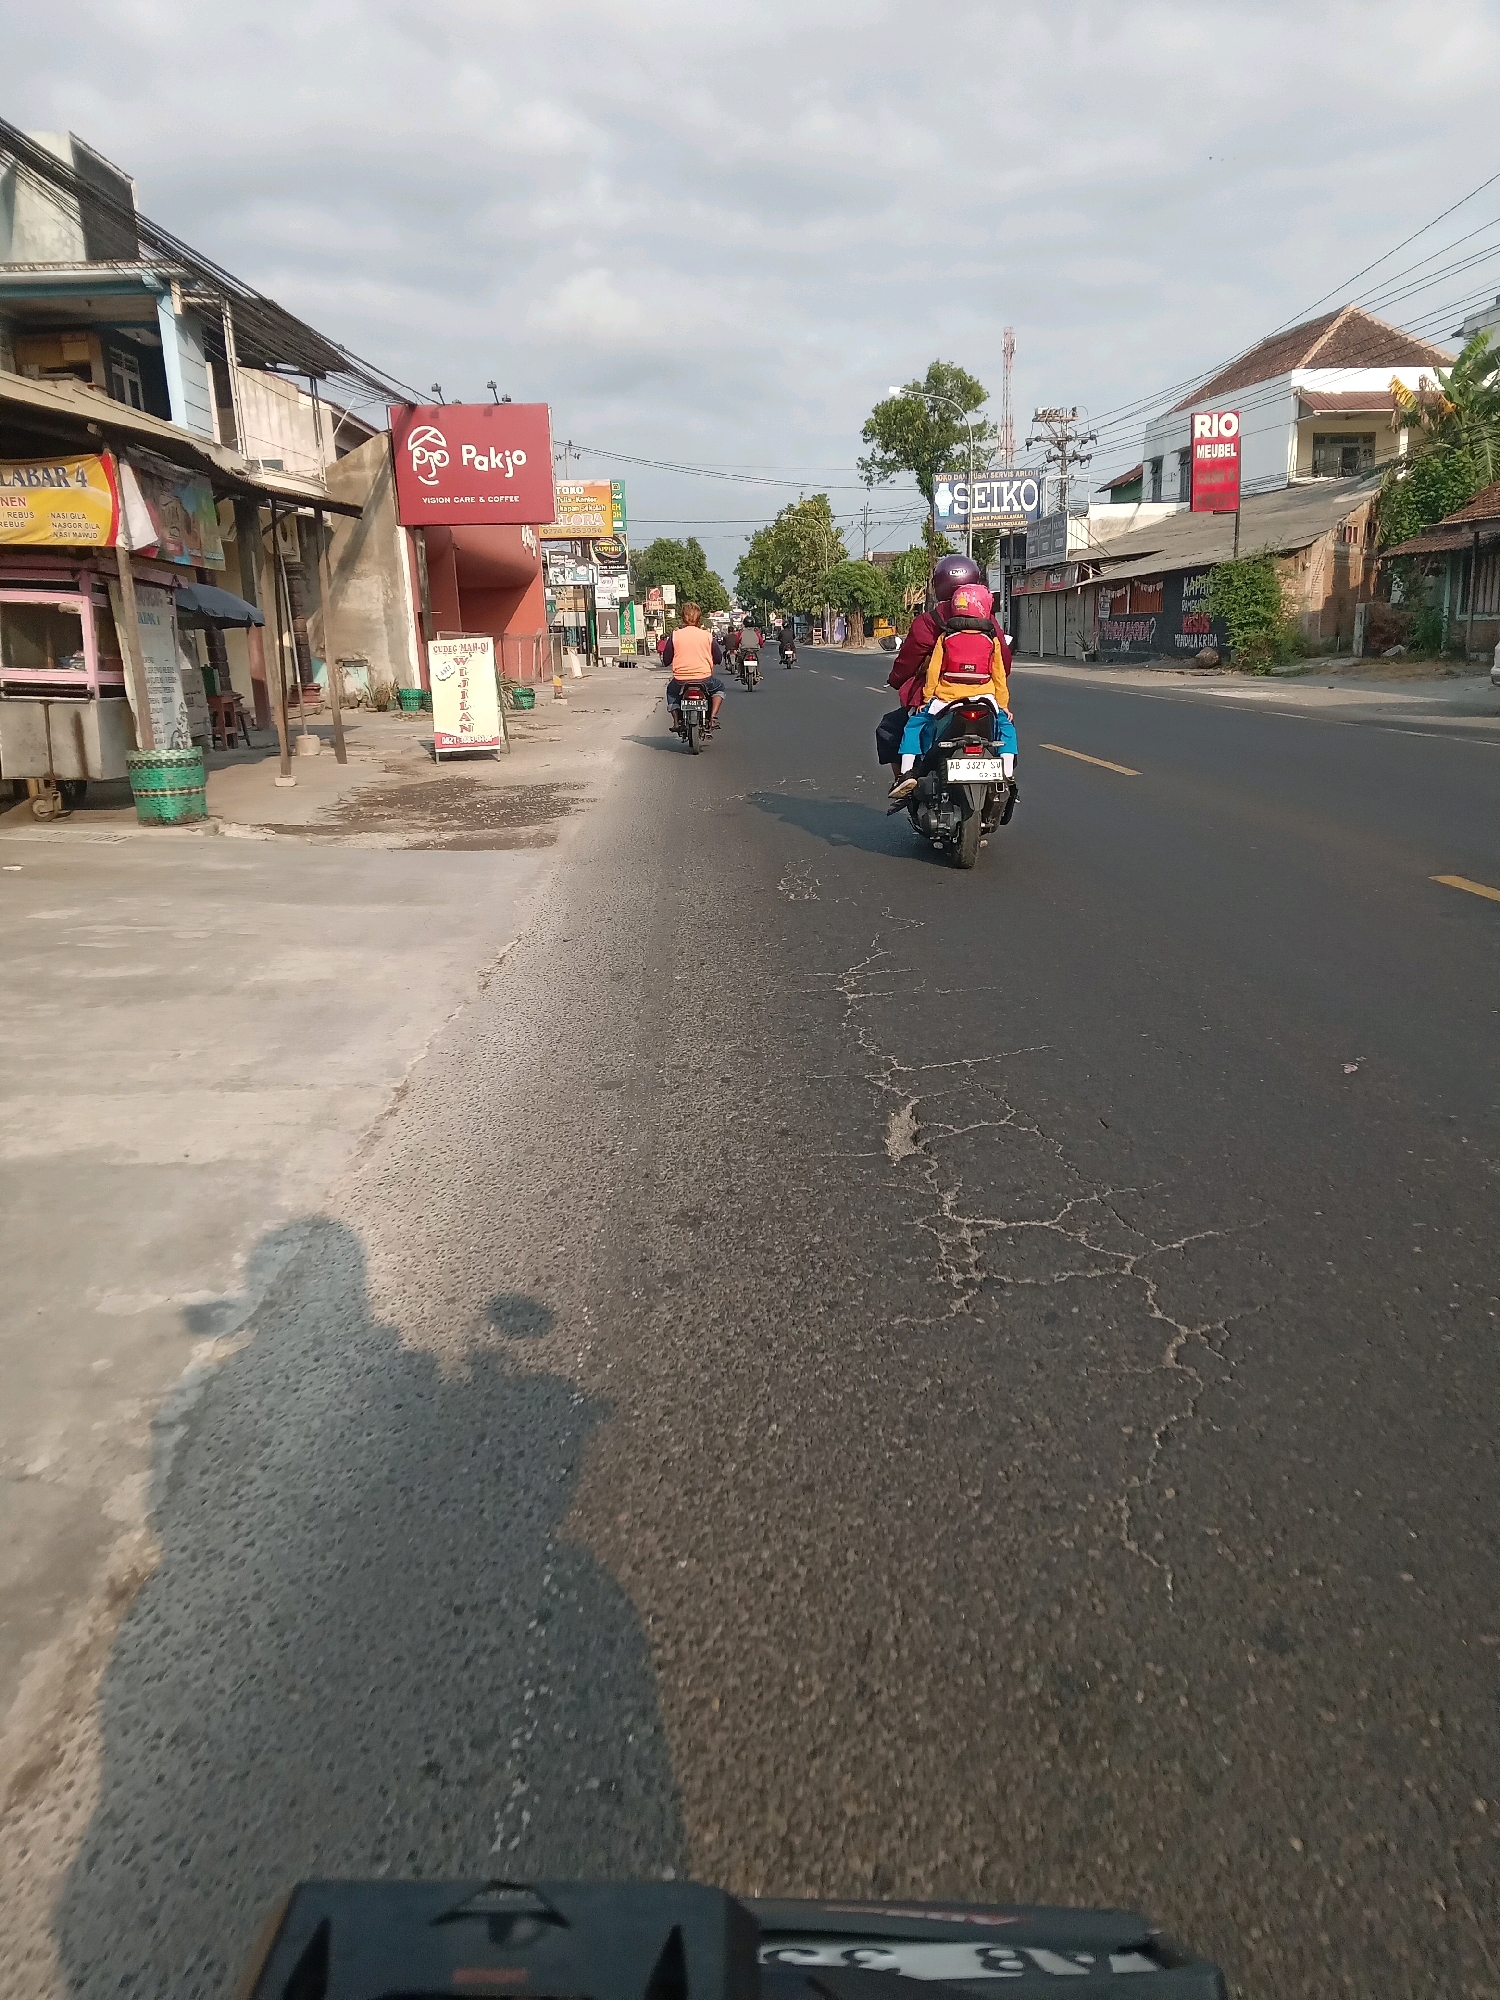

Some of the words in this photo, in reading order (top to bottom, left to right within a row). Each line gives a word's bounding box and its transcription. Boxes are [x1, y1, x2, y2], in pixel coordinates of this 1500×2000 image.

[1194, 412, 1239, 438] RIO
[1197, 443, 1237, 458] MEUBEL
[461, 444, 527, 478] Pakjo
[75, 464, 87, 488] 4
[935, 474, 952, 482] TOKO
[990, 470, 1014, 479] SERVIS
[556, 486, 585, 495] TOKO
[954, 479, 1038, 514] SEIKO
[422, 496, 451, 504] VISION
[487, 495, 520, 503] COFFEE
[7, 511, 35, 519] REBUS
[70, 512, 87, 520] GILA
[85, 522, 101, 530] GILA
[1199, 633, 1218, 648] KRIDA
[950, 761, 961, 770] AB
